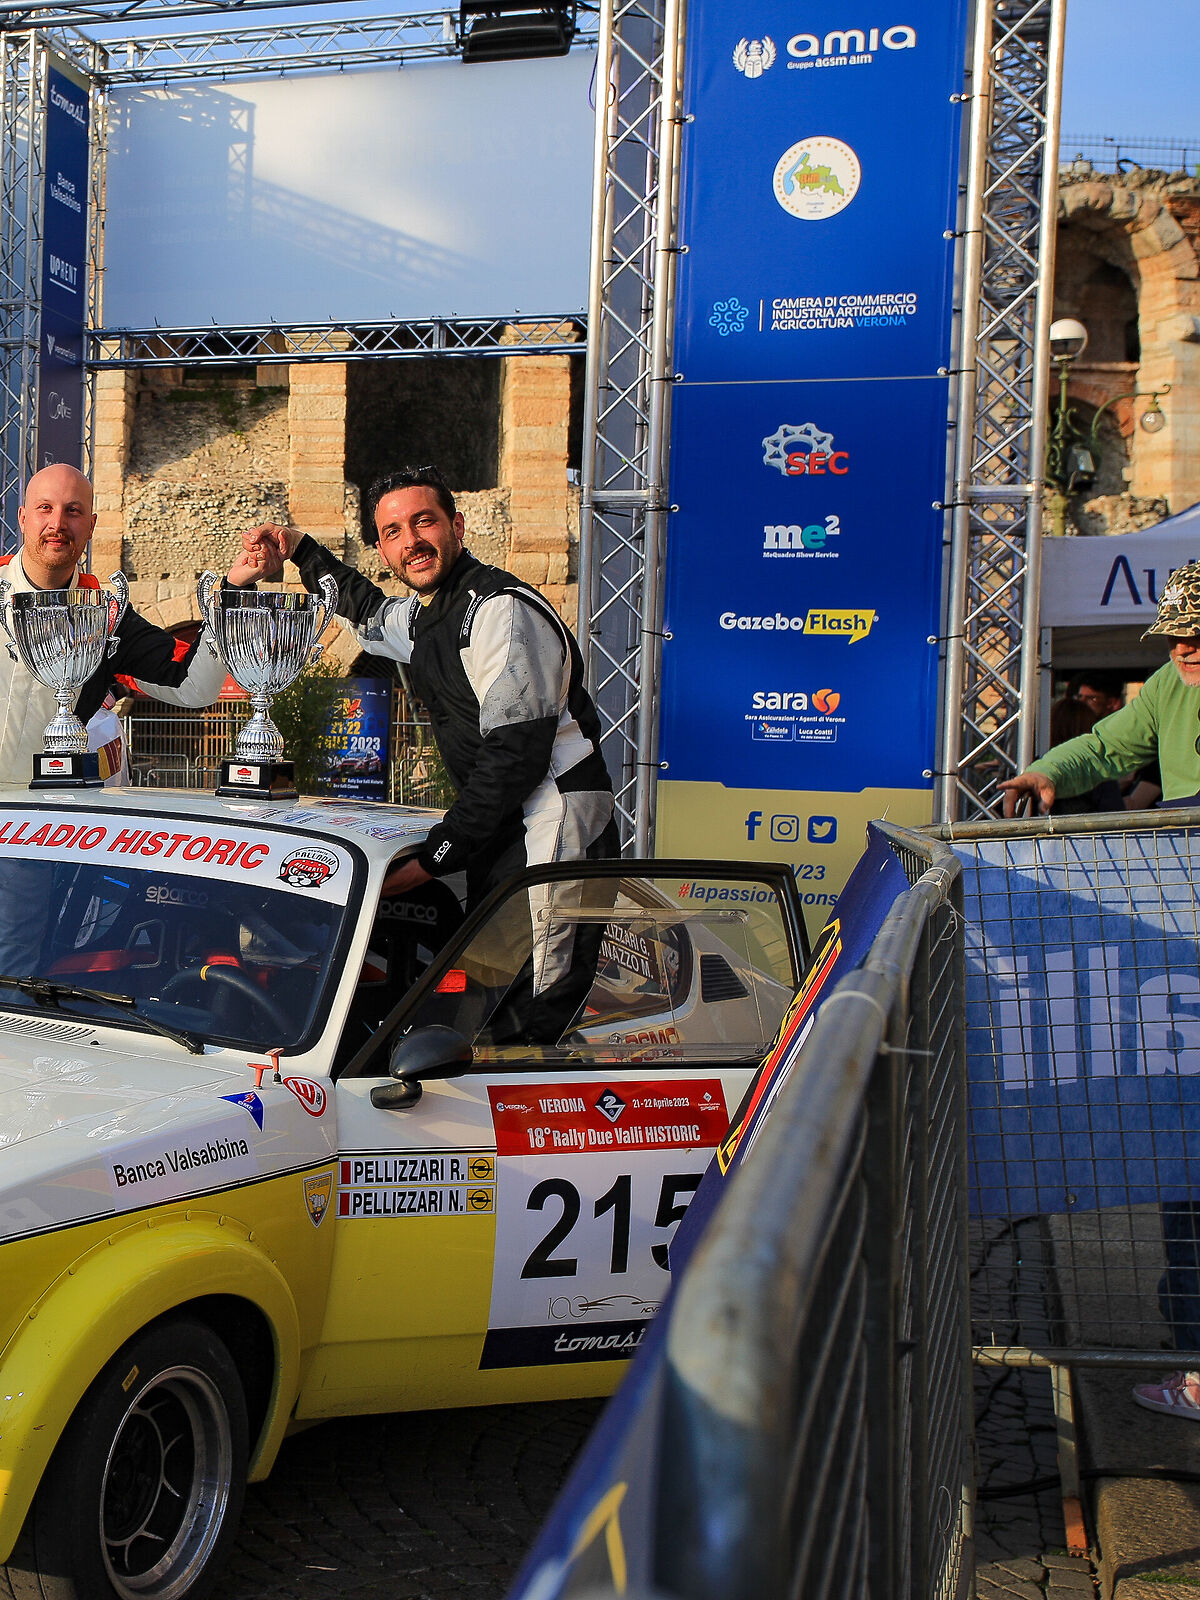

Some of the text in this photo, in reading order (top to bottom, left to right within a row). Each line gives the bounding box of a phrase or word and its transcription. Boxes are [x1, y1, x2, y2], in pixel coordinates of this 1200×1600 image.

[786, 25, 917, 58] amia
[772, 293, 917, 310] CAMERA DI COMMERCIO
[772, 304, 917, 320] INDUSTRIA ARTIGIANATO
[770, 314, 907, 331] AGRICOLTURA VERONA
[786, 451, 849, 476] SEC
[719, 612, 867, 631] Gazebo Flash
[752, 691, 808, 711] sara
[350, 736, 380, 751] 2023
[107, 828, 270, 870] HISTORIC
[295, 851, 336, 866] PALLADIO
[293, 861, 324, 873] HISTORIC
[379, 900, 438, 922] parco
[604, 923, 639, 952] LIZZARI
[599, 941, 639, 973] INAZZO
[538, 1097, 587, 1114] VERONA
[644, 1098, 653, 1108] 22
[653, 1097, 673, 1110] Aprile
[673, 1097, 690, 1107] 2023
[552, 1128, 586, 1150] Rally
[587, 1128, 614, 1146] Due
[614, 1125, 643, 1145] Valli
[644, 1124, 701, 1143] HISTORIC
[113, 1137, 249, 1188] Banca Valsabbina
[353, 1157, 465, 1185] PELLIZZARI R.
[352, 1188, 464, 1216] PELLIZZARI N.
[519, 1172, 704, 1281] 215
[554, 1327, 646, 1353] tomasi
